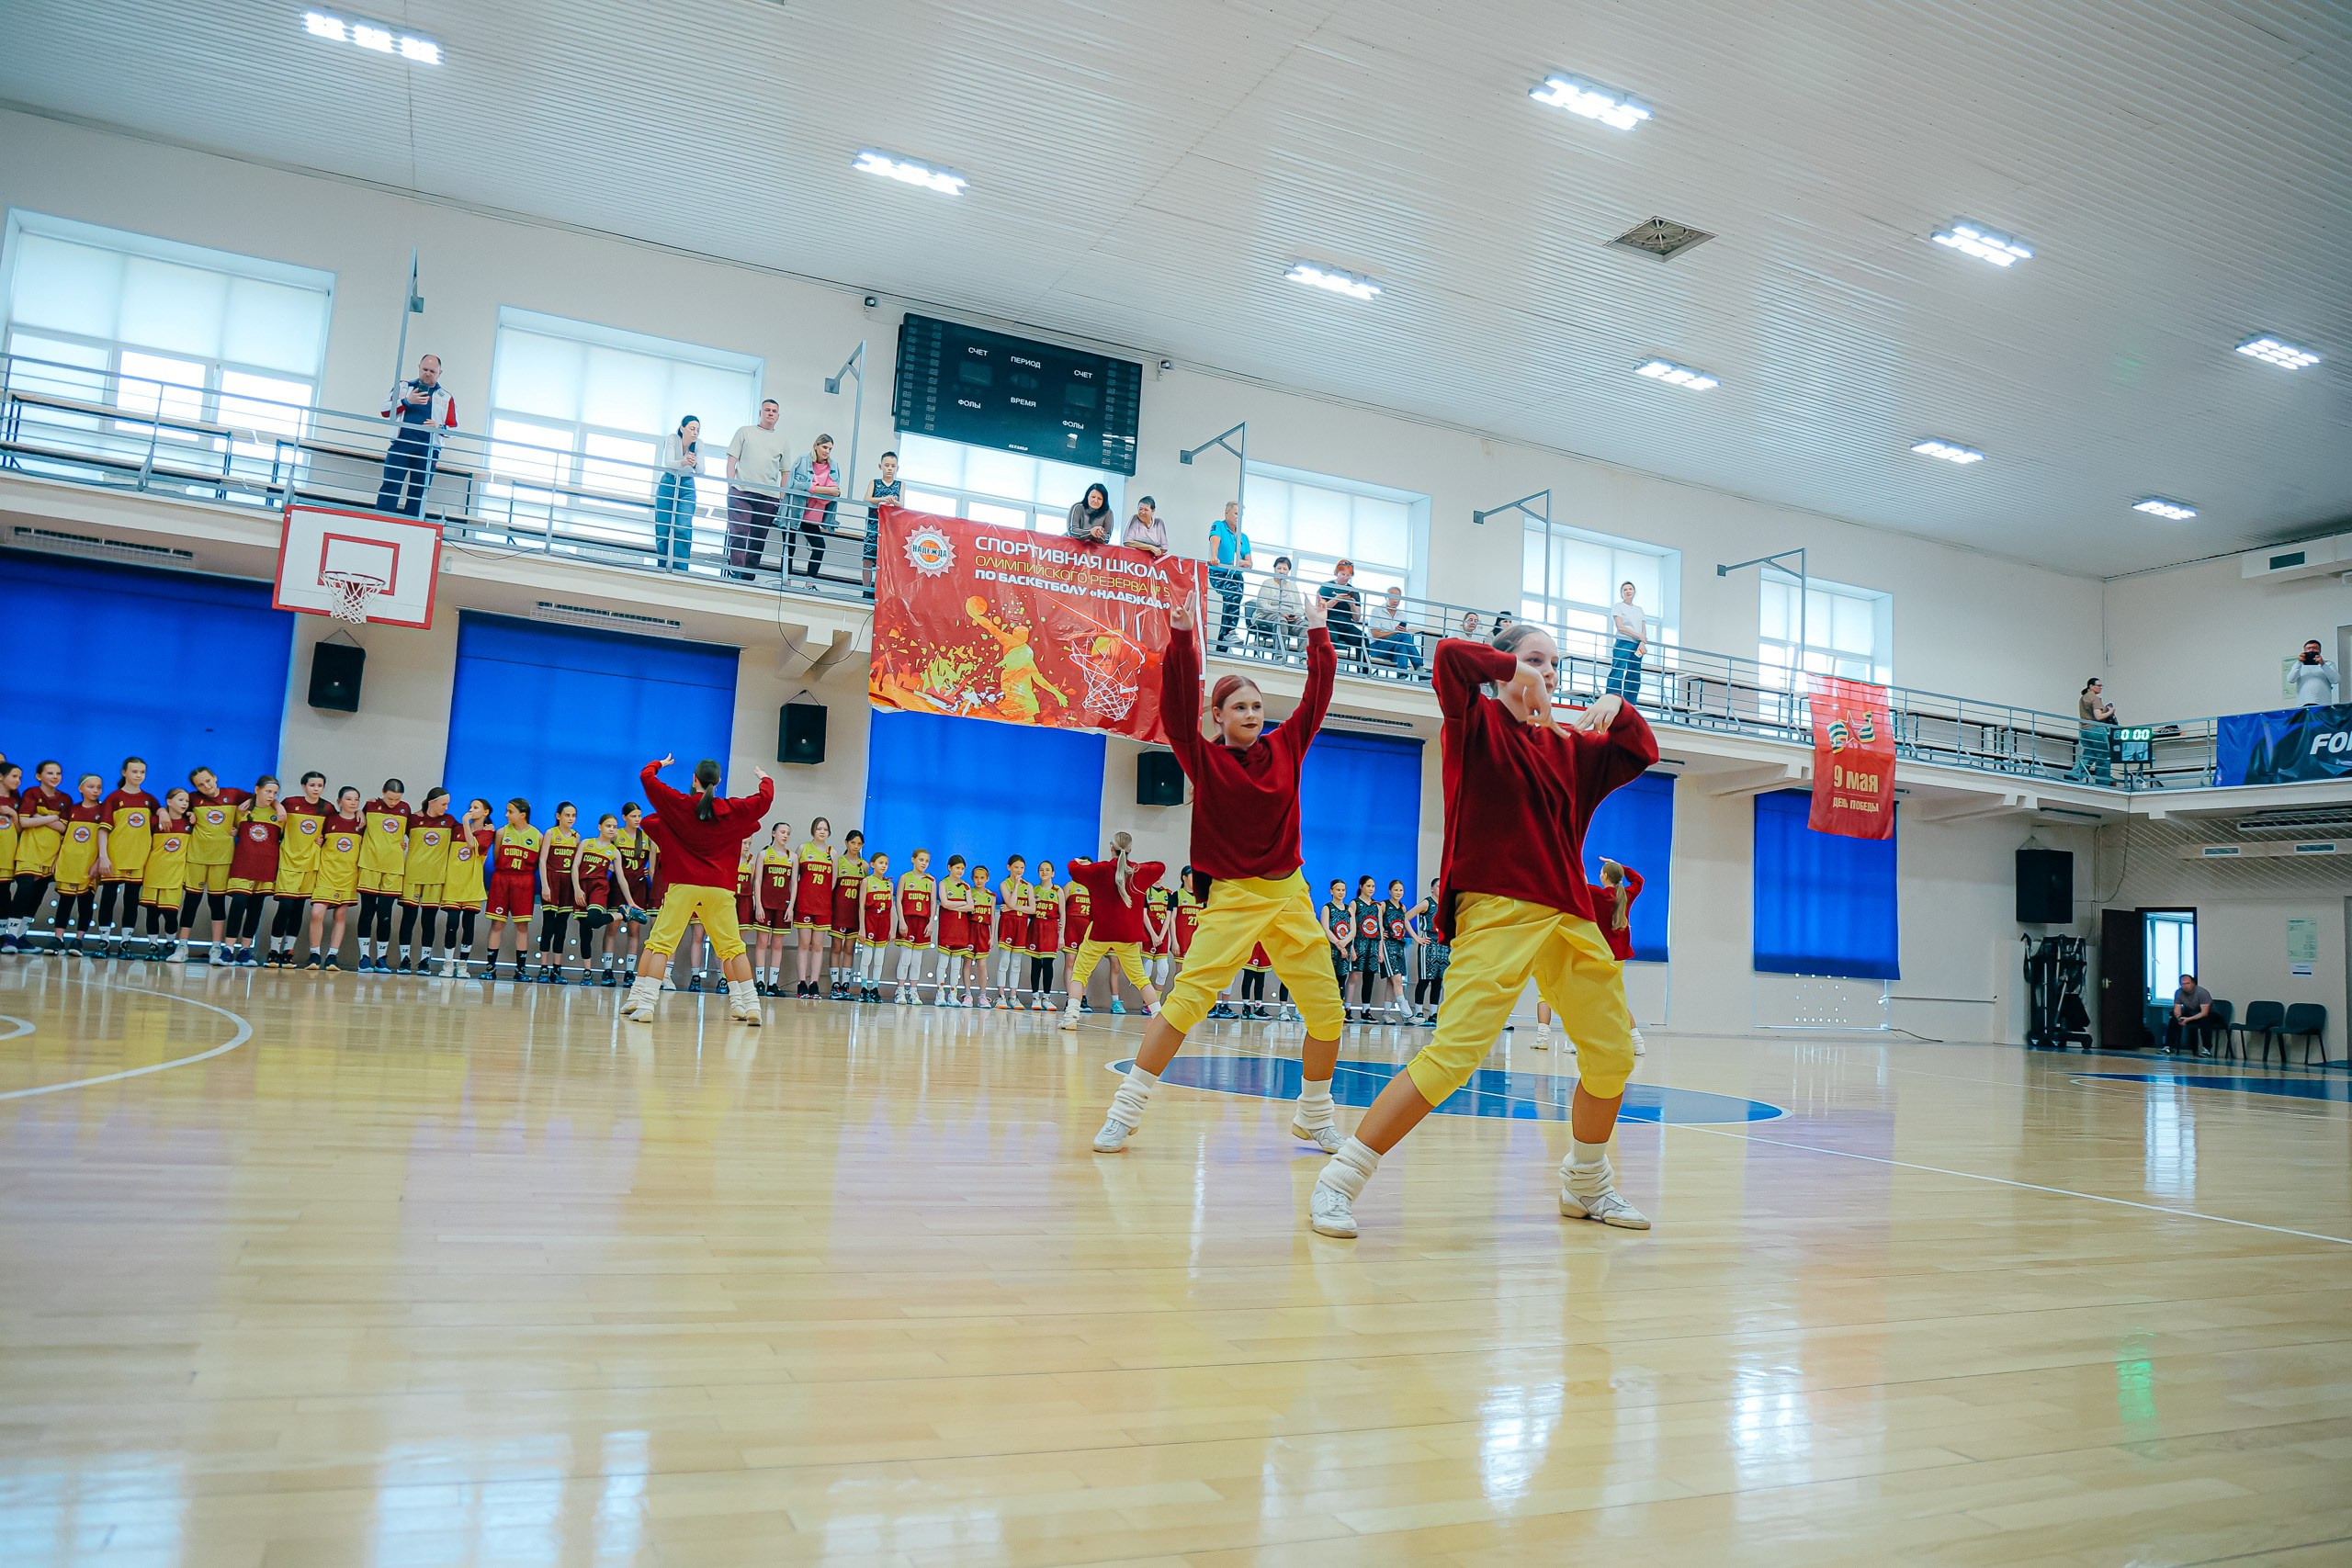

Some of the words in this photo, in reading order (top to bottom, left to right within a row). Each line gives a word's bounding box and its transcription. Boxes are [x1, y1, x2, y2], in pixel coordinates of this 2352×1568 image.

[967, 346, 989, 356] СЧЕТ
[1010, 355, 1041, 369] ПЕРИОД
[1073, 369, 1093, 379] СЧЕТ
[957, 399, 981, 410] ФОЛЫ
[1010, 396, 1036, 408] ВРЕМЯ
[1062, 420, 1084, 430] ФОЛЫ
[912, 544, 947, 558] НАДЕЖДА
[975, 536, 1102, 570] СПОРТИВНАЯ
[1105, 558, 1170, 584] ШКОЛА
[975, 555, 1089, 583] ОЛИМПИЙСКОГО
[1090, 572, 1148, 592] РЕЗЕРВА
[975, 569, 997, 581] ПО
[998, 571, 1087, 596] БАСКЕТБОЛУ
[1089, 589, 1171, 610] «НАДЕЖДА»
[1834, 764, 1843, 788] 9
[1832, 796, 1849, 808] ДЕНЬ
[1849, 799, 1879, 813] ПОБЕДЫ
[585, 864, 596, 874] 7
[773, 875, 786, 887] 10
[811, 873, 824, 885] 79
[844, 887, 858, 899] 40
[915, 901, 922, 912] 9
